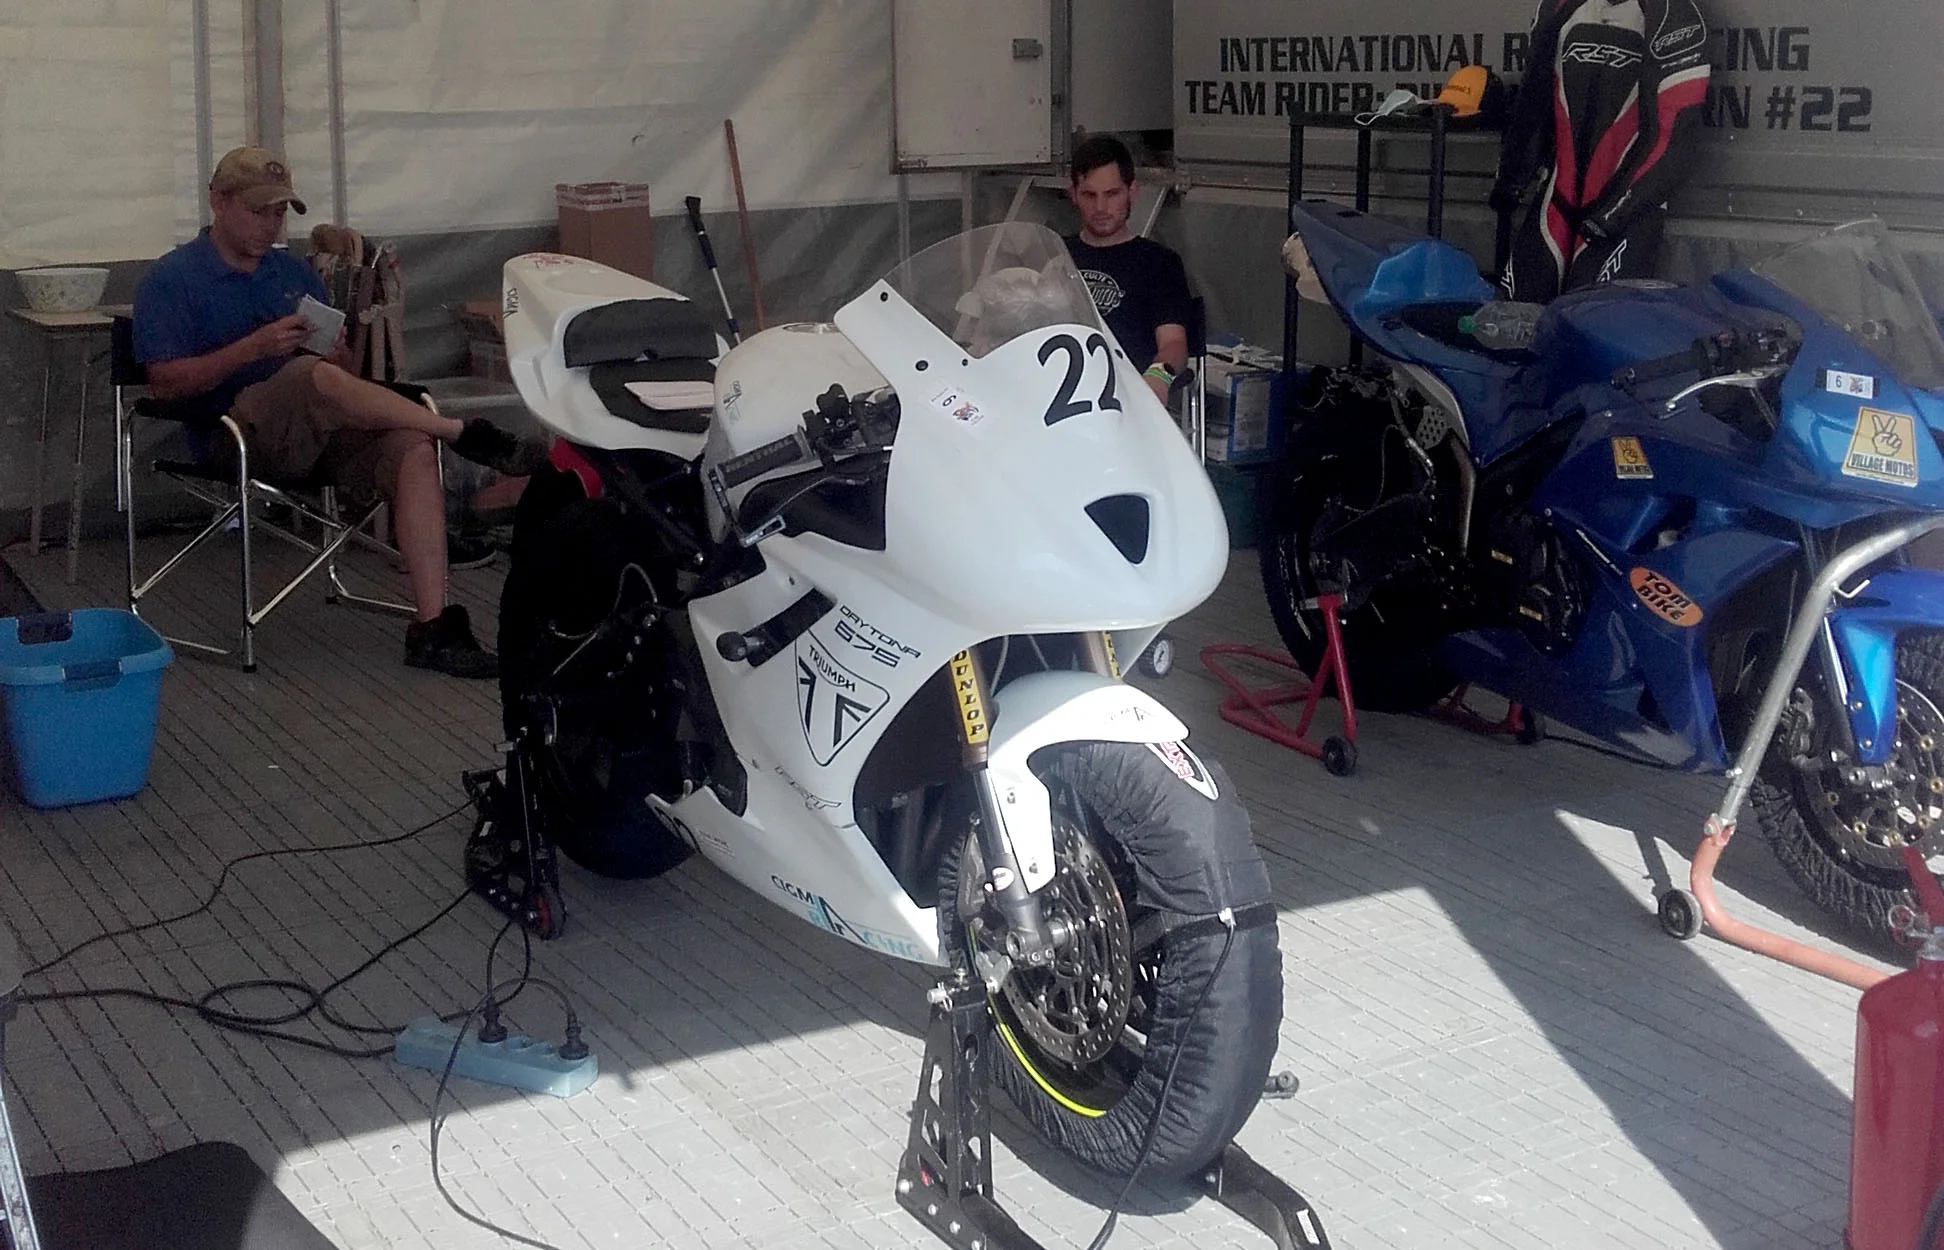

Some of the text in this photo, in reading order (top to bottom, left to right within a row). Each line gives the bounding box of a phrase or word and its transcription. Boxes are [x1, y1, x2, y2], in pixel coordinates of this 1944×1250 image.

[1219, 33, 1491, 72] INTERNATIONAL
[1561, 42, 1643, 68] RST
[1184, 81, 1266, 116] TEAM
[1764, 86, 1873, 132] #22
[1037, 333, 1122, 427] 22
[1835, 375, 1842, 388] 6
[942, 394, 957, 407] 6
[1851, 453, 1884, 472] VILLAGE
[1636, 584, 1685, 620] BIKE
[1643, 572, 1692, 609] TOM
[834, 620, 901, 668] 675
[840, 605, 922, 658] DAYTONA
[809, 644, 856, 692] TRIUMPH
[953, 650, 984, 737] DUNLOP
